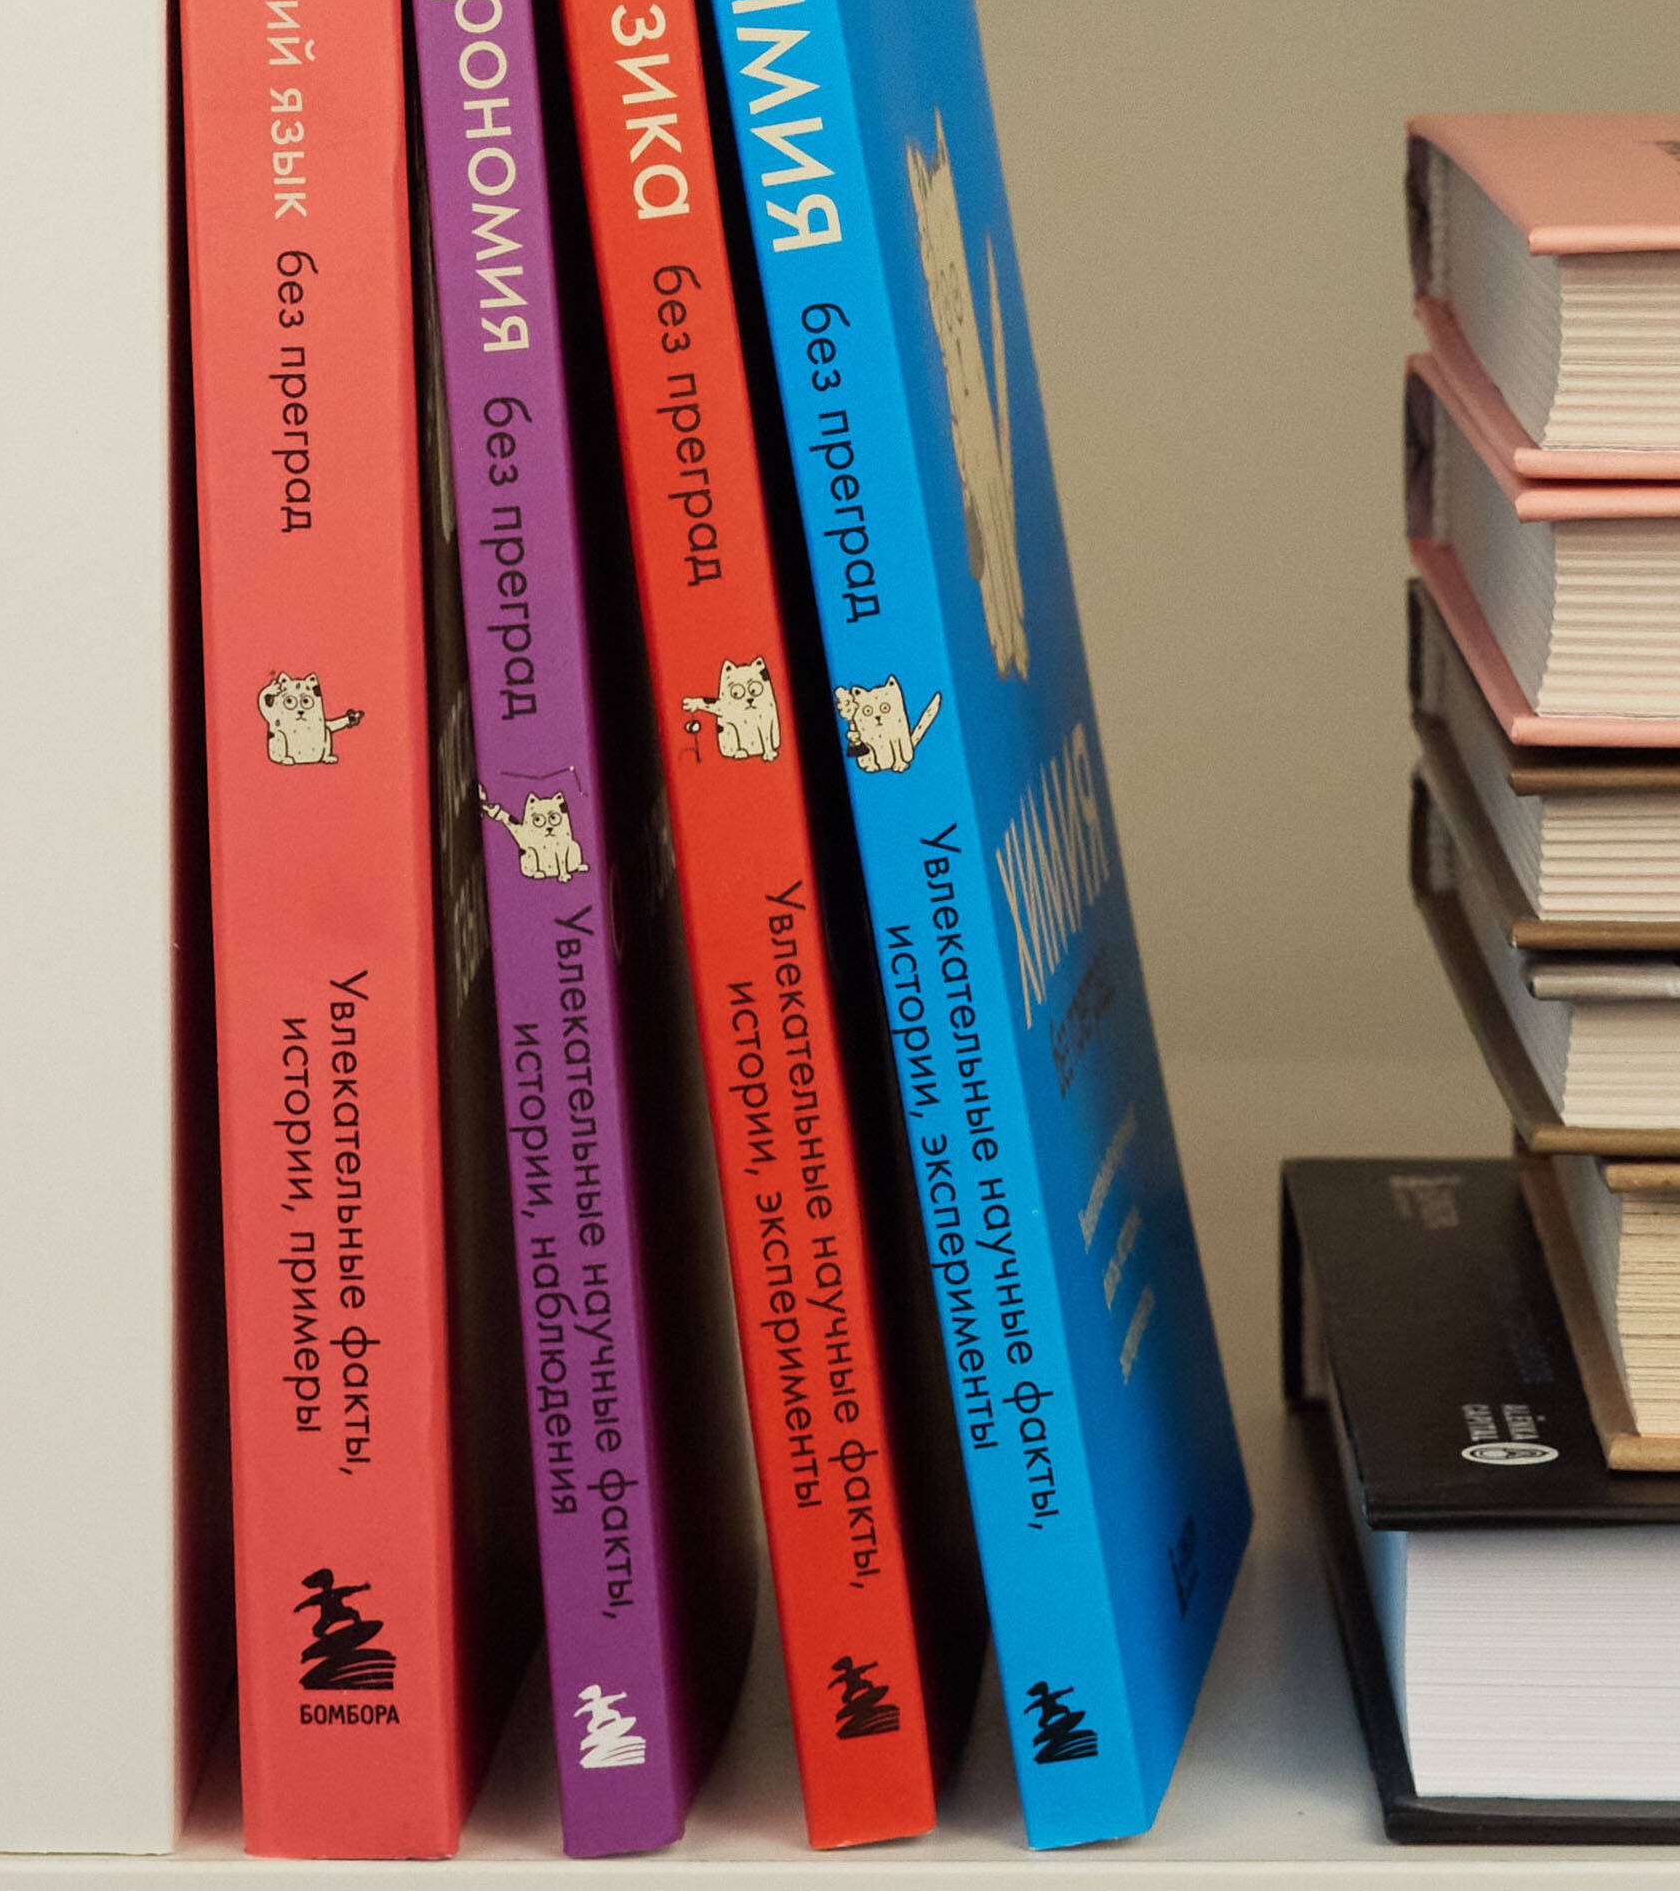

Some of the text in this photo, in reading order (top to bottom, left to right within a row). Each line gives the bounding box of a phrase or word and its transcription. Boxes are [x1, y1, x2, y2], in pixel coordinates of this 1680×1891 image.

[270, 88, 308, 220] язык
[276, 250, 319, 329] без
[653, 265, 702, 355] без
[801, 303, 851, 392] без
[268, 346, 312, 533] преград
[483, 397, 533, 487] без
[657, 372, 723, 587] преград
[809, 410, 881, 625] преград
[479, 505, 538, 721] преград
[273, 1018, 321, 1432] истории, примеры
[329, 970, 381, 1475] Увлекательные факты,
[508, 1023, 578, 1515] истории, наблюдения
[553, 905, 639, 1619] Увлекательные научные факты,
[728, 981, 822, 1508] истории, эксперименты
[766, 880, 880, 1589] Увлекательные научные факты,
[886, 925, 999, 1451] истории, эксперименты
[920, 823, 1059, 1530] Увлекательные научные факты,
[299, 1704, 400, 1725] БОМБОРА
